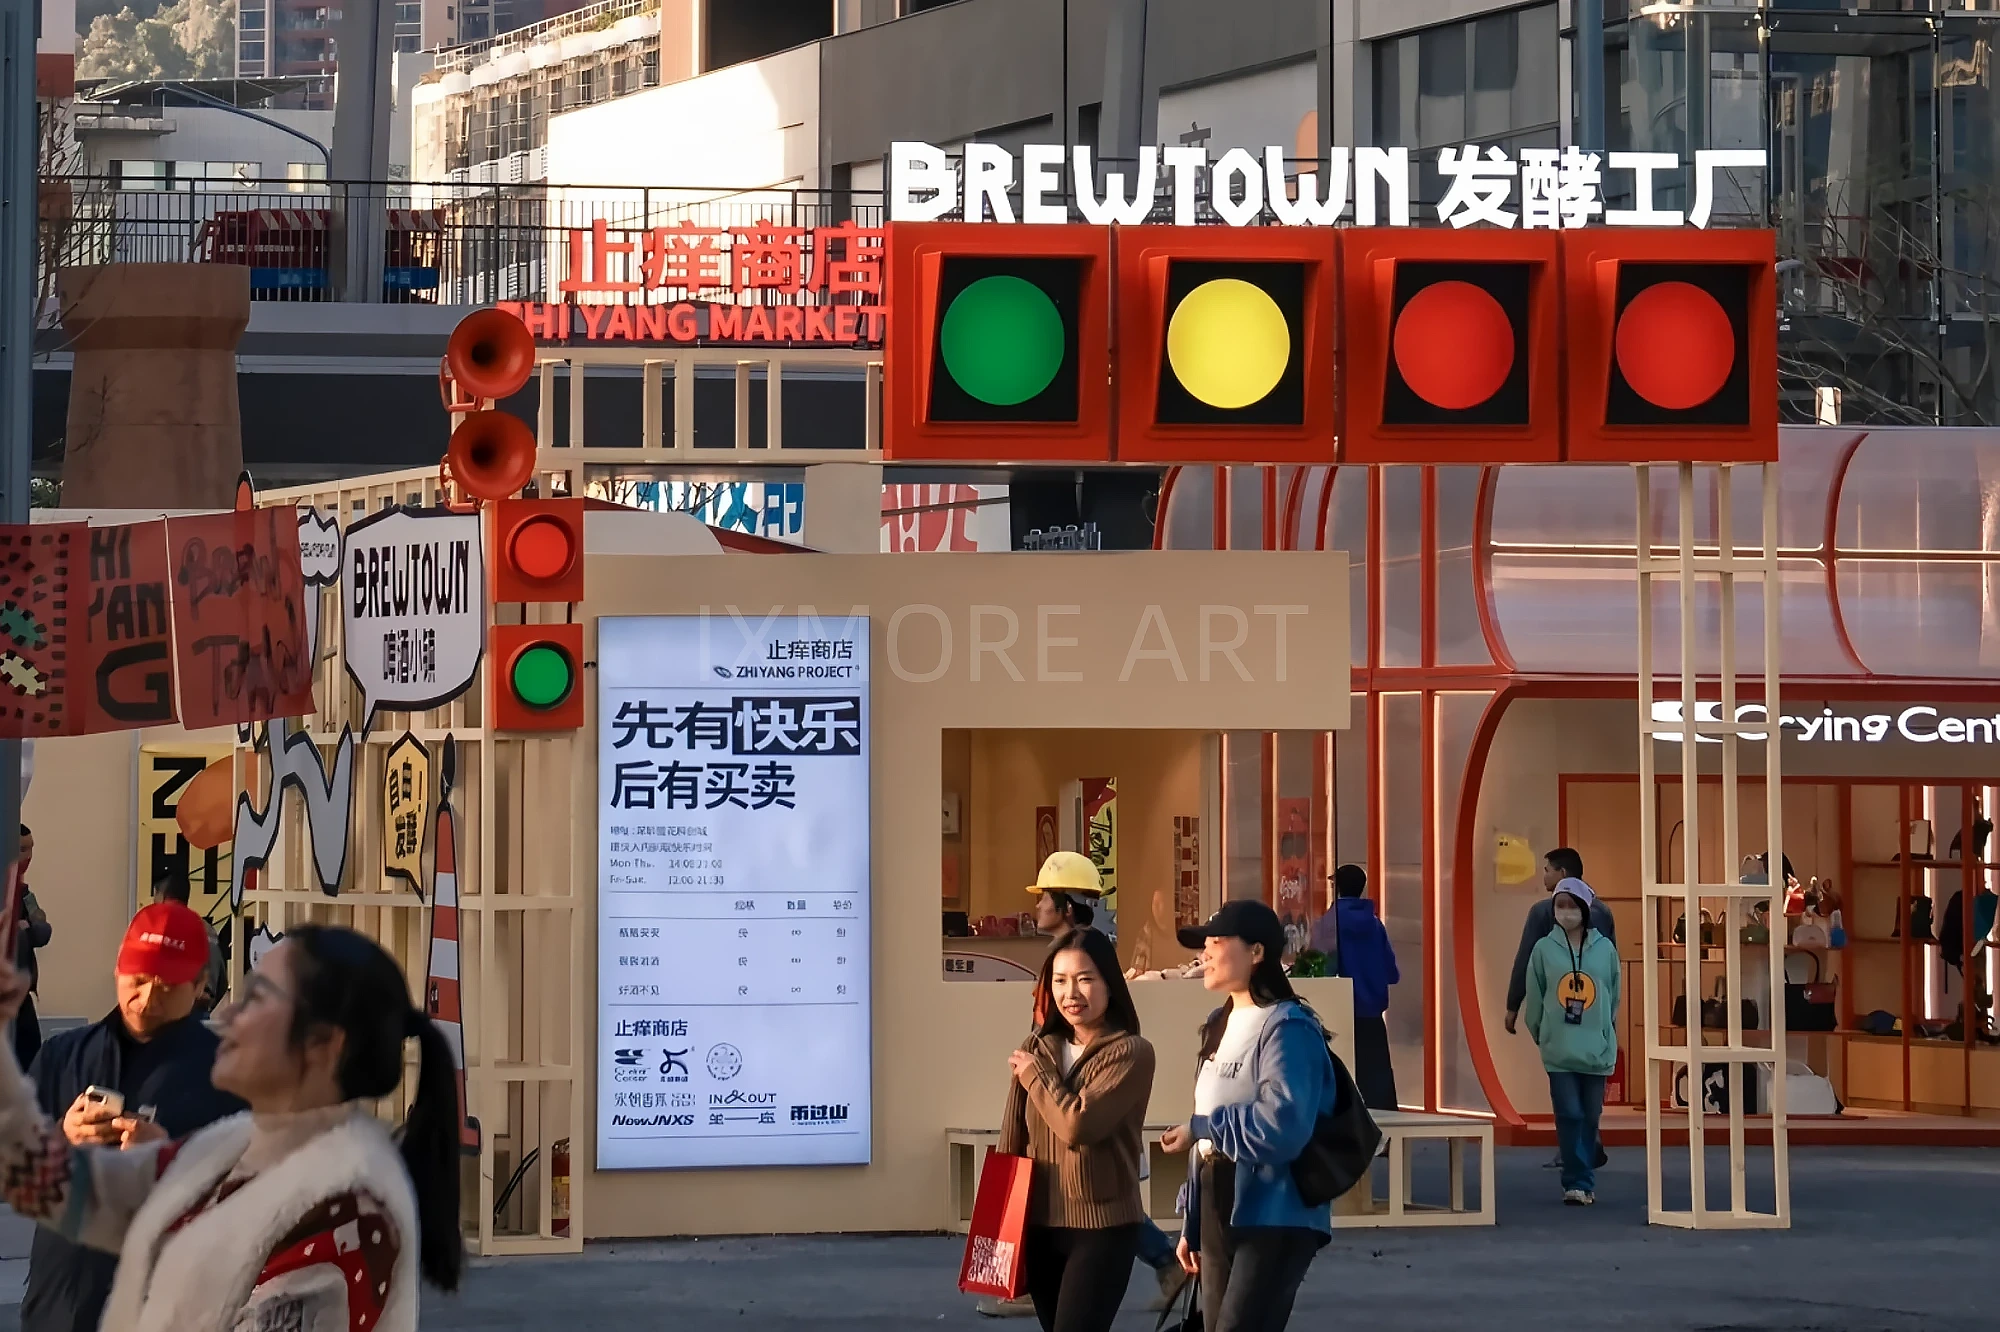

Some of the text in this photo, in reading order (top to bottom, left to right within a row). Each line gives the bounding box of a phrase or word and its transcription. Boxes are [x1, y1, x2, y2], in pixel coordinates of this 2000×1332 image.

[891, 140, 1410, 228] BREWTOWN
[1437, 143, 1768, 230] 发酵工厂
[559, 218, 885, 294] 止痒商店
[709, 303, 887, 342] MARKET
[353, 540, 470, 619] BREWTOWN
[767, 639, 853, 660] 止痒商店
[798, 665, 852, 679] PROJECT
[611, 699, 860, 752] 先有快乐
[609, 760, 797, 810] 后有买卖
